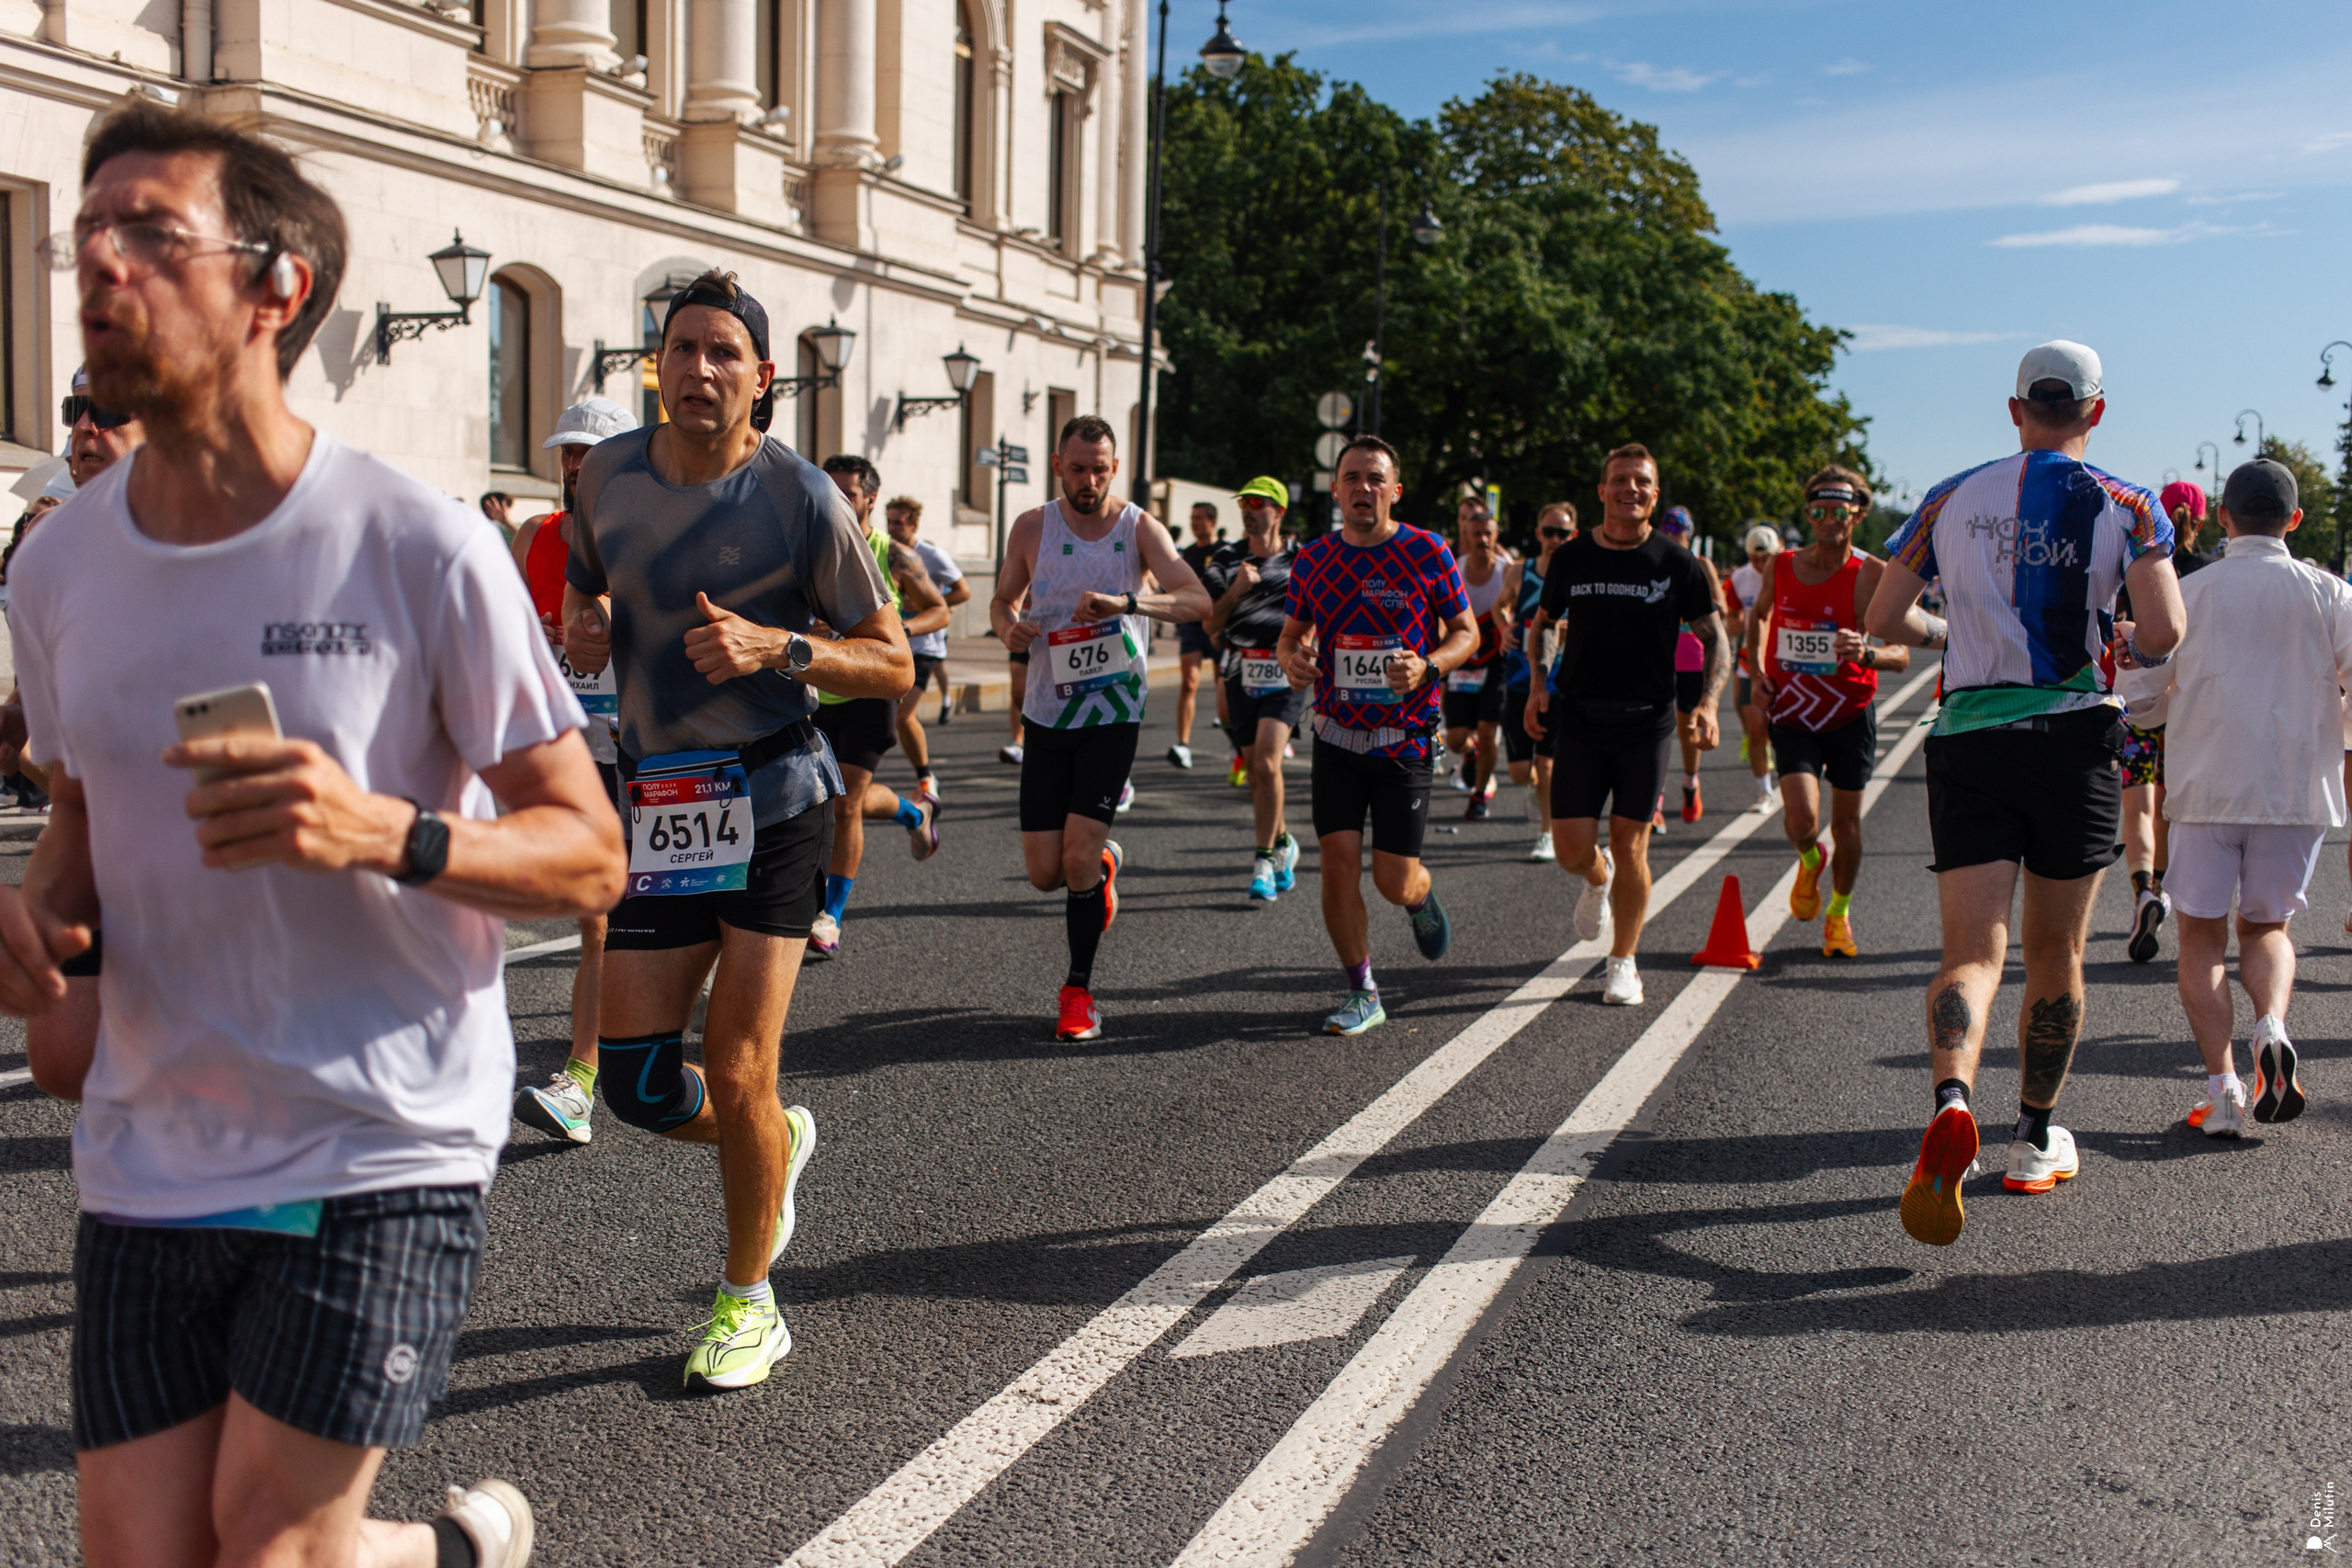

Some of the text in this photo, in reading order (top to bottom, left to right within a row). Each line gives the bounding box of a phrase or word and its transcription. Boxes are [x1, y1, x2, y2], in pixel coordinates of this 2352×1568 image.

[1362, 580, 1386, 588] ПОЛУ
[1570, 582, 1649, 597] BACK TO GODHEAD
[1362, 589, 1408, 598] МАРАФОН
[1786, 633, 1829, 654] 1355
[1069, 642, 1109, 670] 676
[1079, 666, 1103, 676] ПАВЕЛ
[1247, 663, 1283, 678] 2780
[567, 680, 599, 690] ИХАИЛ
[1063, 684, 1073, 696] B
[1340, 689, 1349, 701] B
[642, 783, 661, 791] ПОЛУ
[643, 789, 679, 798] МАРАФОН
[695, 781, 731, 795] 21,1 КМ
[649, 809, 740, 852] 6514
[670, 849, 715, 863] СЕРГЕЙ
[636, 875, 652, 891] C
